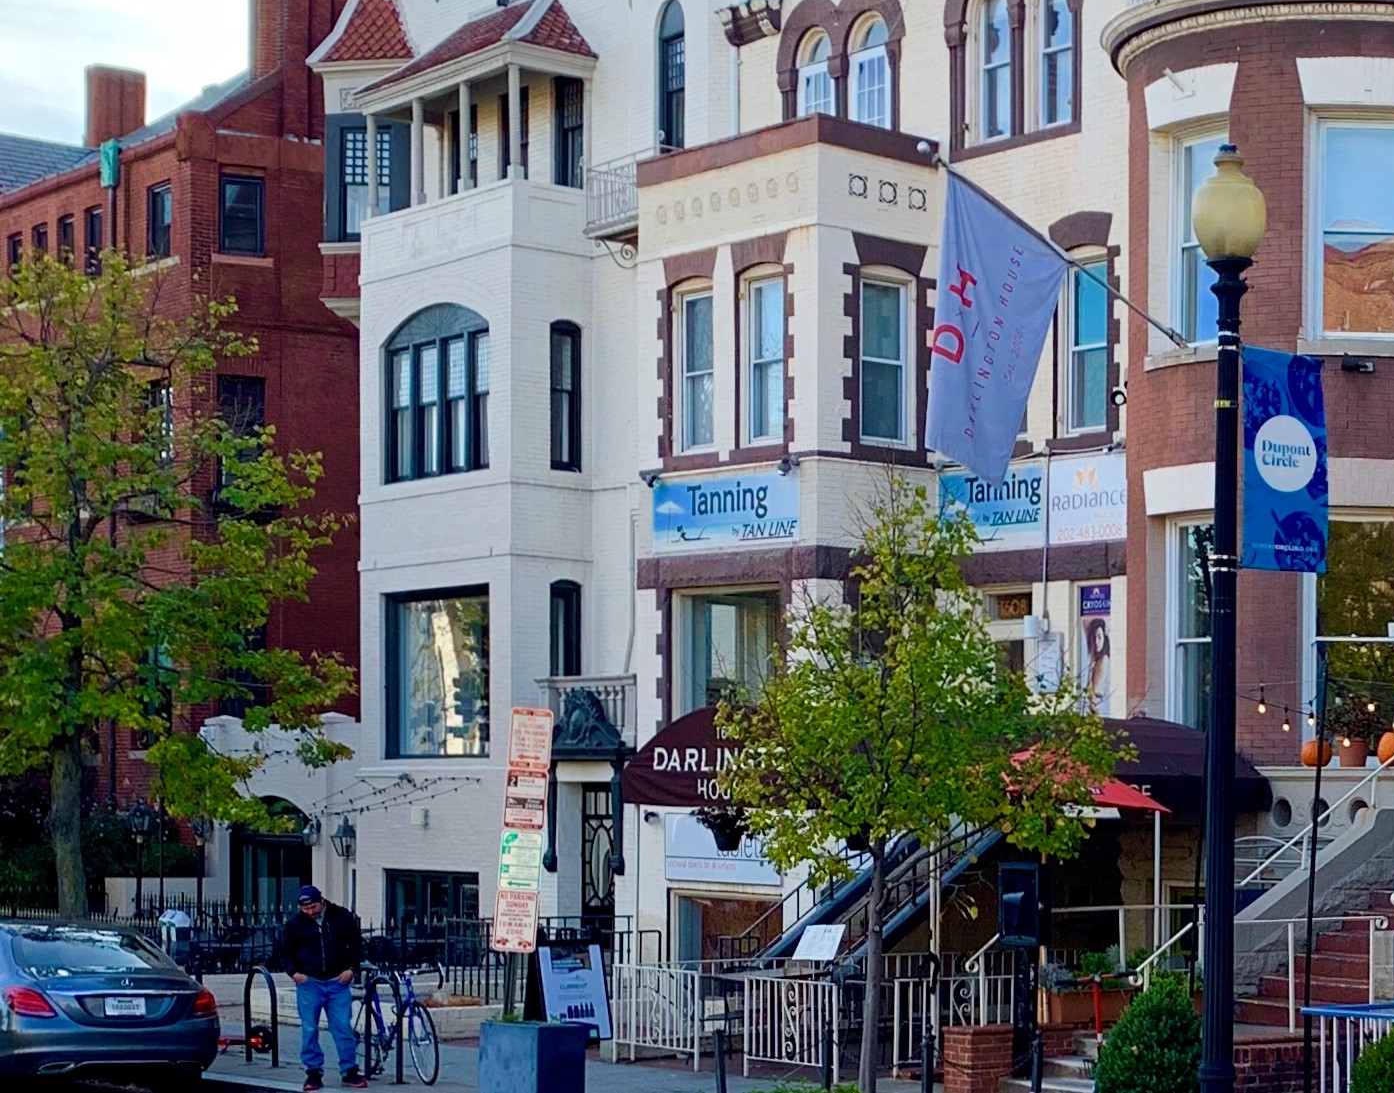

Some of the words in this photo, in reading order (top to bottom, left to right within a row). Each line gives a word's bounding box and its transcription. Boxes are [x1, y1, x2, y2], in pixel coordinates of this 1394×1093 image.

[964, 315, 1004, 439] DARLINGTON
[997, 244, 1024, 308] HOUSE
[1261, 439, 1311, 457] Dupont
[1261, 453, 1300, 468] Circle
[965, 473, 1042, 506] Tanning
[687, 481, 769, 519] Tanning
[992, 509, 1014, 525] TAN
[1016, 507, 1041, 523] LINE
[742, 521, 767, 539] TAN
[768, 519, 798, 537] LINE
[1057, 524, 1122, 542] 202-483-0008
